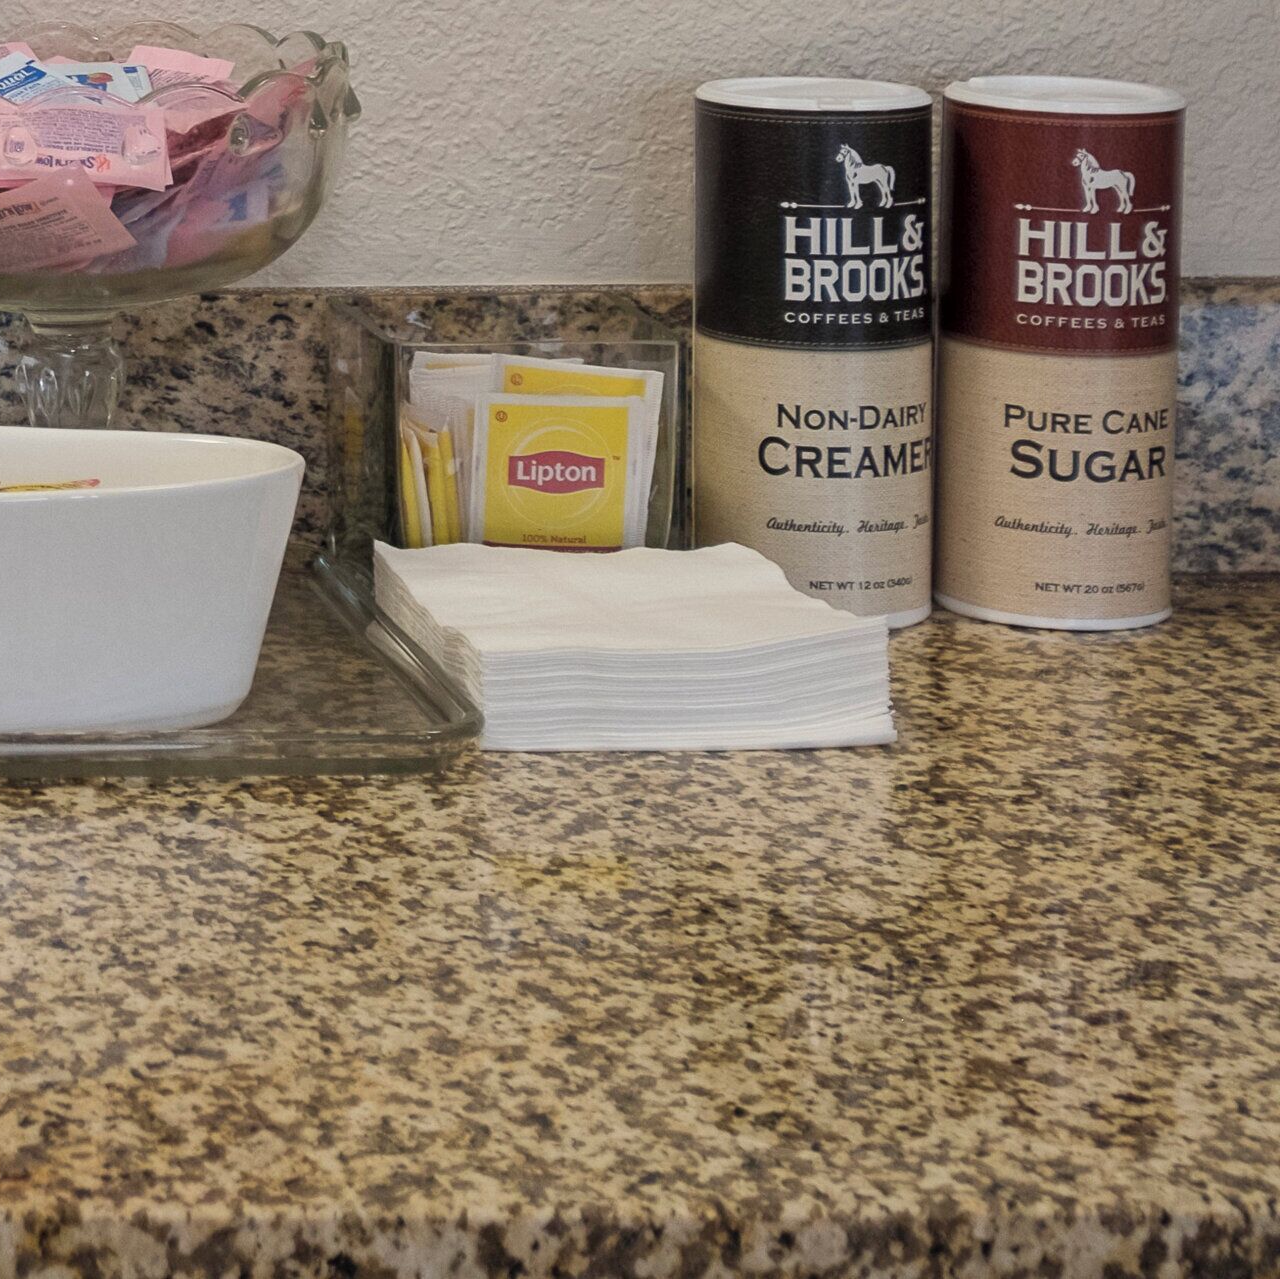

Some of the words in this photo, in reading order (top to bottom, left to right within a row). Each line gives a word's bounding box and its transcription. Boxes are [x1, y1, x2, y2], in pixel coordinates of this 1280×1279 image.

[784, 216, 898, 255] HILL
[902, 213, 924, 252] &
[1018, 218, 1136, 260] HILL
[1142, 221, 1168, 258] &
[784, 254, 924, 302] BROOKS
[1017, 260, 1166, 307] BROOKS
[784, 311, 873, 325] COFFEES
[879, 312, 889, 323] &
[894, 307, 925, 322] TEAS
[1016, 313, 1107, 329] COFFEES
[1114, 318, 1124, 329] &
[1132, 314, 1165, 328] TEAS
[777, 402, 927, 430] NON-DAIRY
[1003, 403, 1092, 435] PURE
[1102, 407, 1169, 435] CANE
[516, 460, 596, 485] Lipton
[1010, 439, 1167, 484] SUGAR
[766, 516, 849, 537] Authenticity.
[994, 516, 1077, 538] Authenticity.
[809, 581, 833, 590] NET
[836, 581, 855, 590] WT
[859, 581, 871, 590] 12
[1035, 582, 1060, 592] NET
[1062, 584, 1082, 594] WT
[1084, 584, 1098, 594] 20
